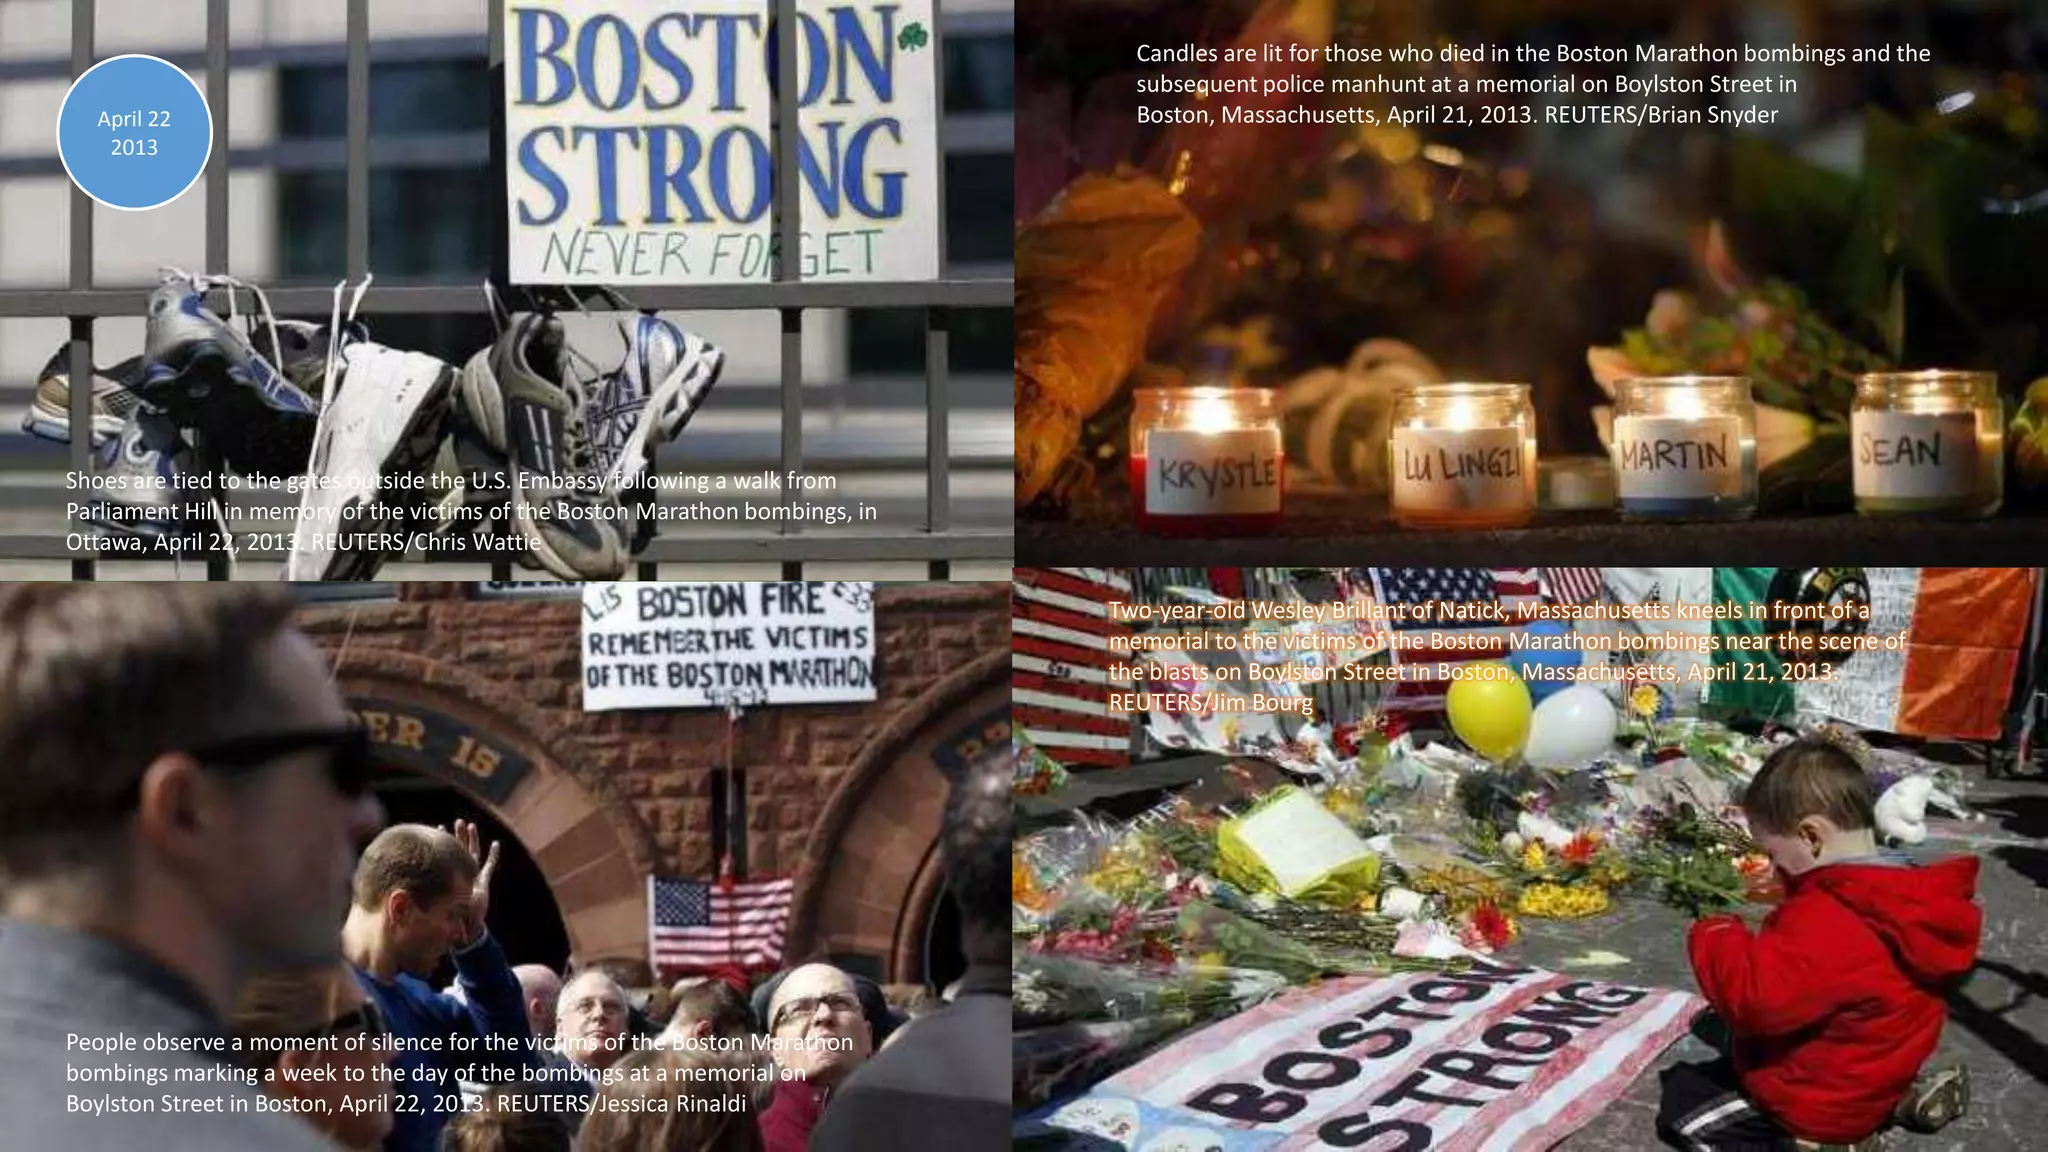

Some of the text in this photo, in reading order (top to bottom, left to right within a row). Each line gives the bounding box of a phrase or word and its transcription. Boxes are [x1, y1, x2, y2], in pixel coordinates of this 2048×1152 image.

[512, 5, 902, 112] BOSTON
[517, 117, 908, 227] STRONG
[542, 228, 691, 276] NEVER
[1620, 432, 1728, 472] MARTIN
[1859, 430, 1942, 468] SEAN
[1158, 454, 1277, 498] KRYSTLE
[638, 581, 826, 622] BOSTON FIRE
[588, 625, 869, 657] REMEMBER THE VICTIMS
[586, 655, 877, 690] OF THE BOSTON MARATHON
[1185, 961, 1535, 1123] BOSTON
[1317, 981, 1649, 1152] STRONG
